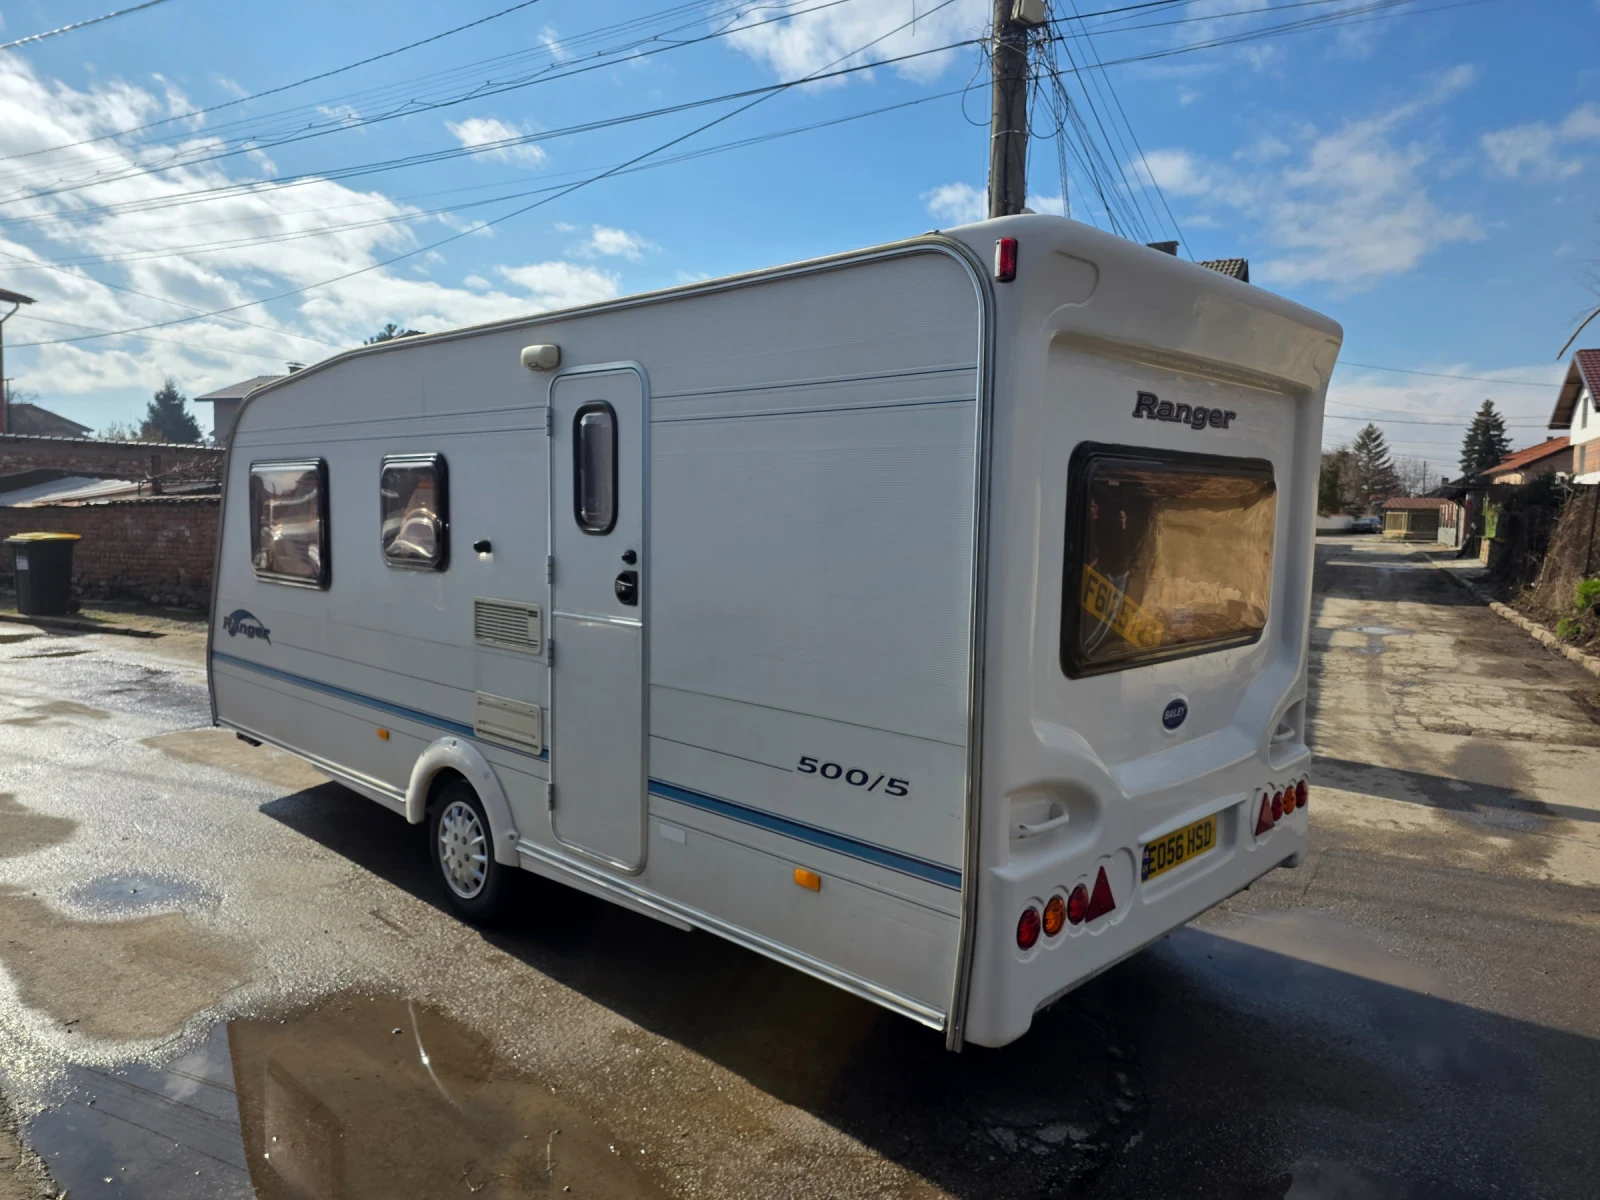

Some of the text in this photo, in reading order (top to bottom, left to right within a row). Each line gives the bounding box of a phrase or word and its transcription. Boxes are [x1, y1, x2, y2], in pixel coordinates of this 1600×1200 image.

[1132, 391, 1236, 430] Ranger
[797, 756, 909, 797] 500/5
[1148, 820, 1212, 875] EO56 HSD
